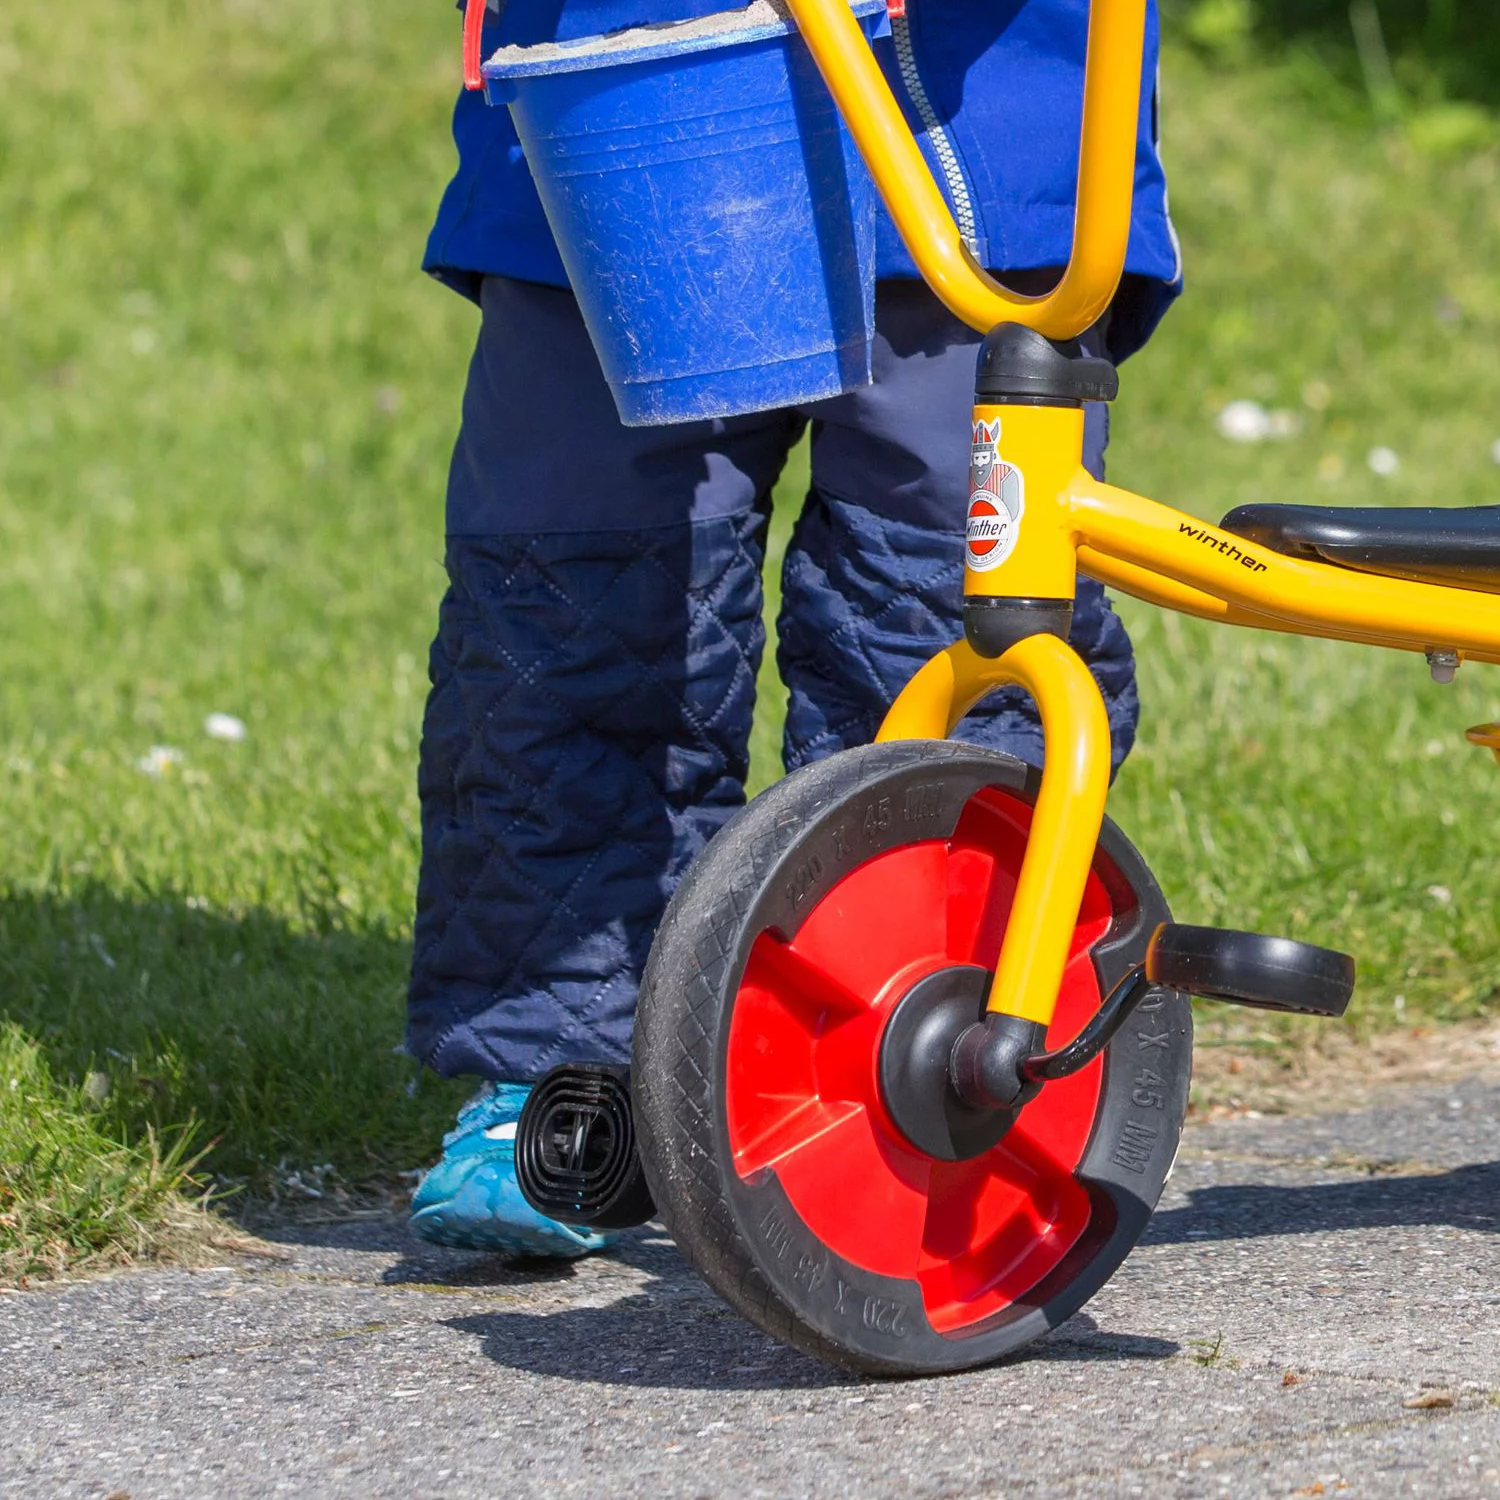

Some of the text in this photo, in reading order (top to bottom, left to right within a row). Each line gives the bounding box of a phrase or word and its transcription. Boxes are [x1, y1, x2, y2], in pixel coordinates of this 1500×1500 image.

[1179, 522, 1268, 572] winther
[785, 853, 825, 911] 220
[863, 796, 892, 836] 45
[1137, 1032, 1170, 1051] X
[1131, 1068, 1169, 1111] 45
[1112, 1119, 1158, 1175] MM
[862, 1295, 909, 1338] 220
